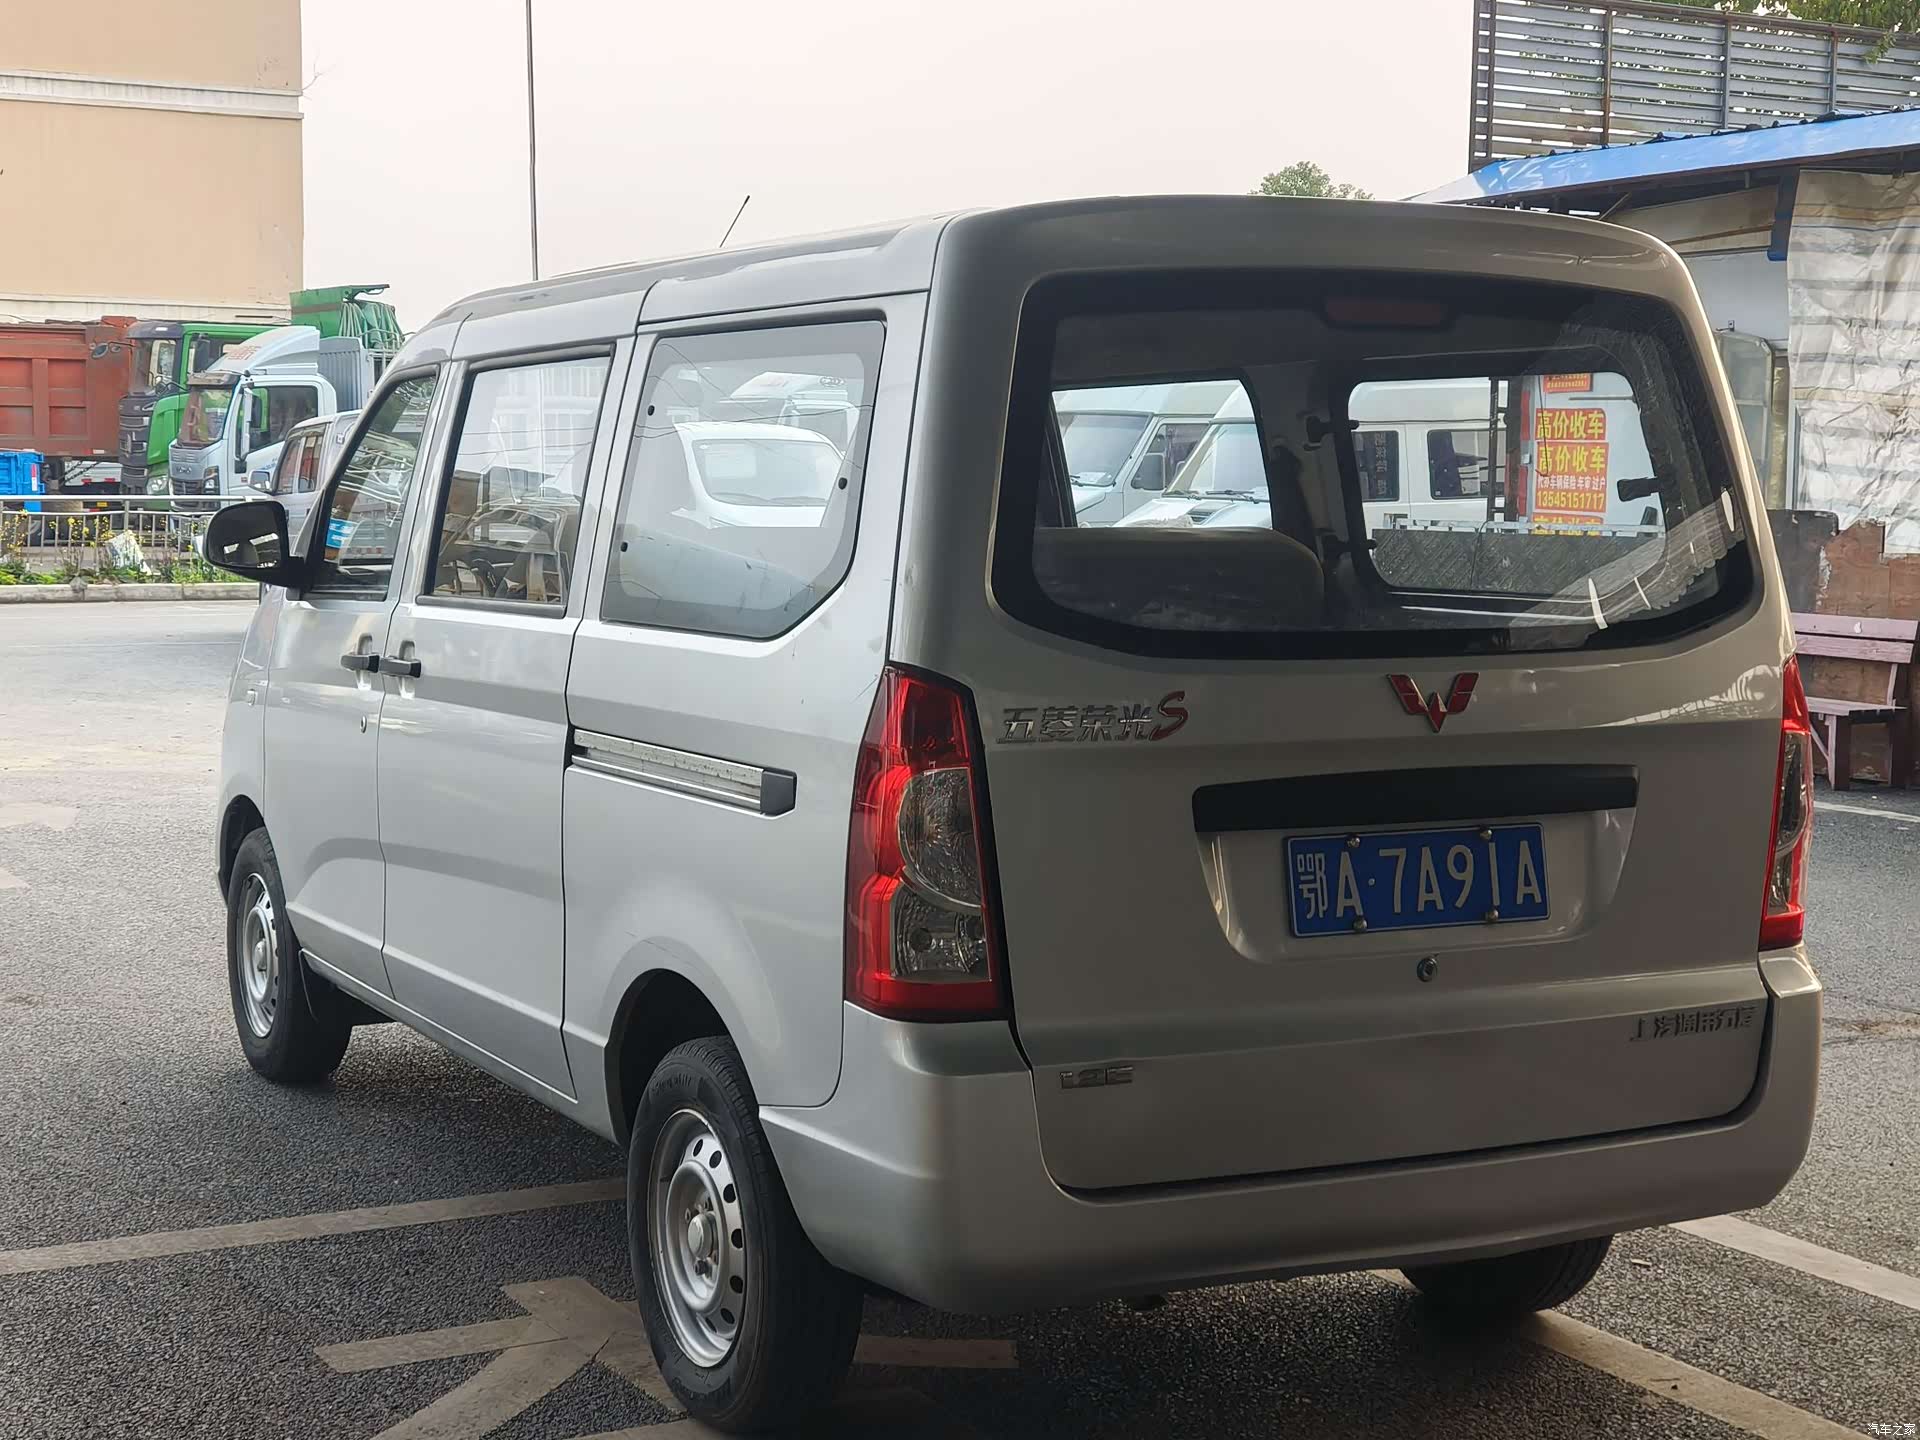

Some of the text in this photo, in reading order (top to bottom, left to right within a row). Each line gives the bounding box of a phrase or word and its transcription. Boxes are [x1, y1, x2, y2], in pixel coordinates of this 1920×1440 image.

[1537, 411, 1605, 439] 高价收车
[1539, 445, 1606, 473] 高价收车
[1537, 491, 1605, 510] 13545151717
